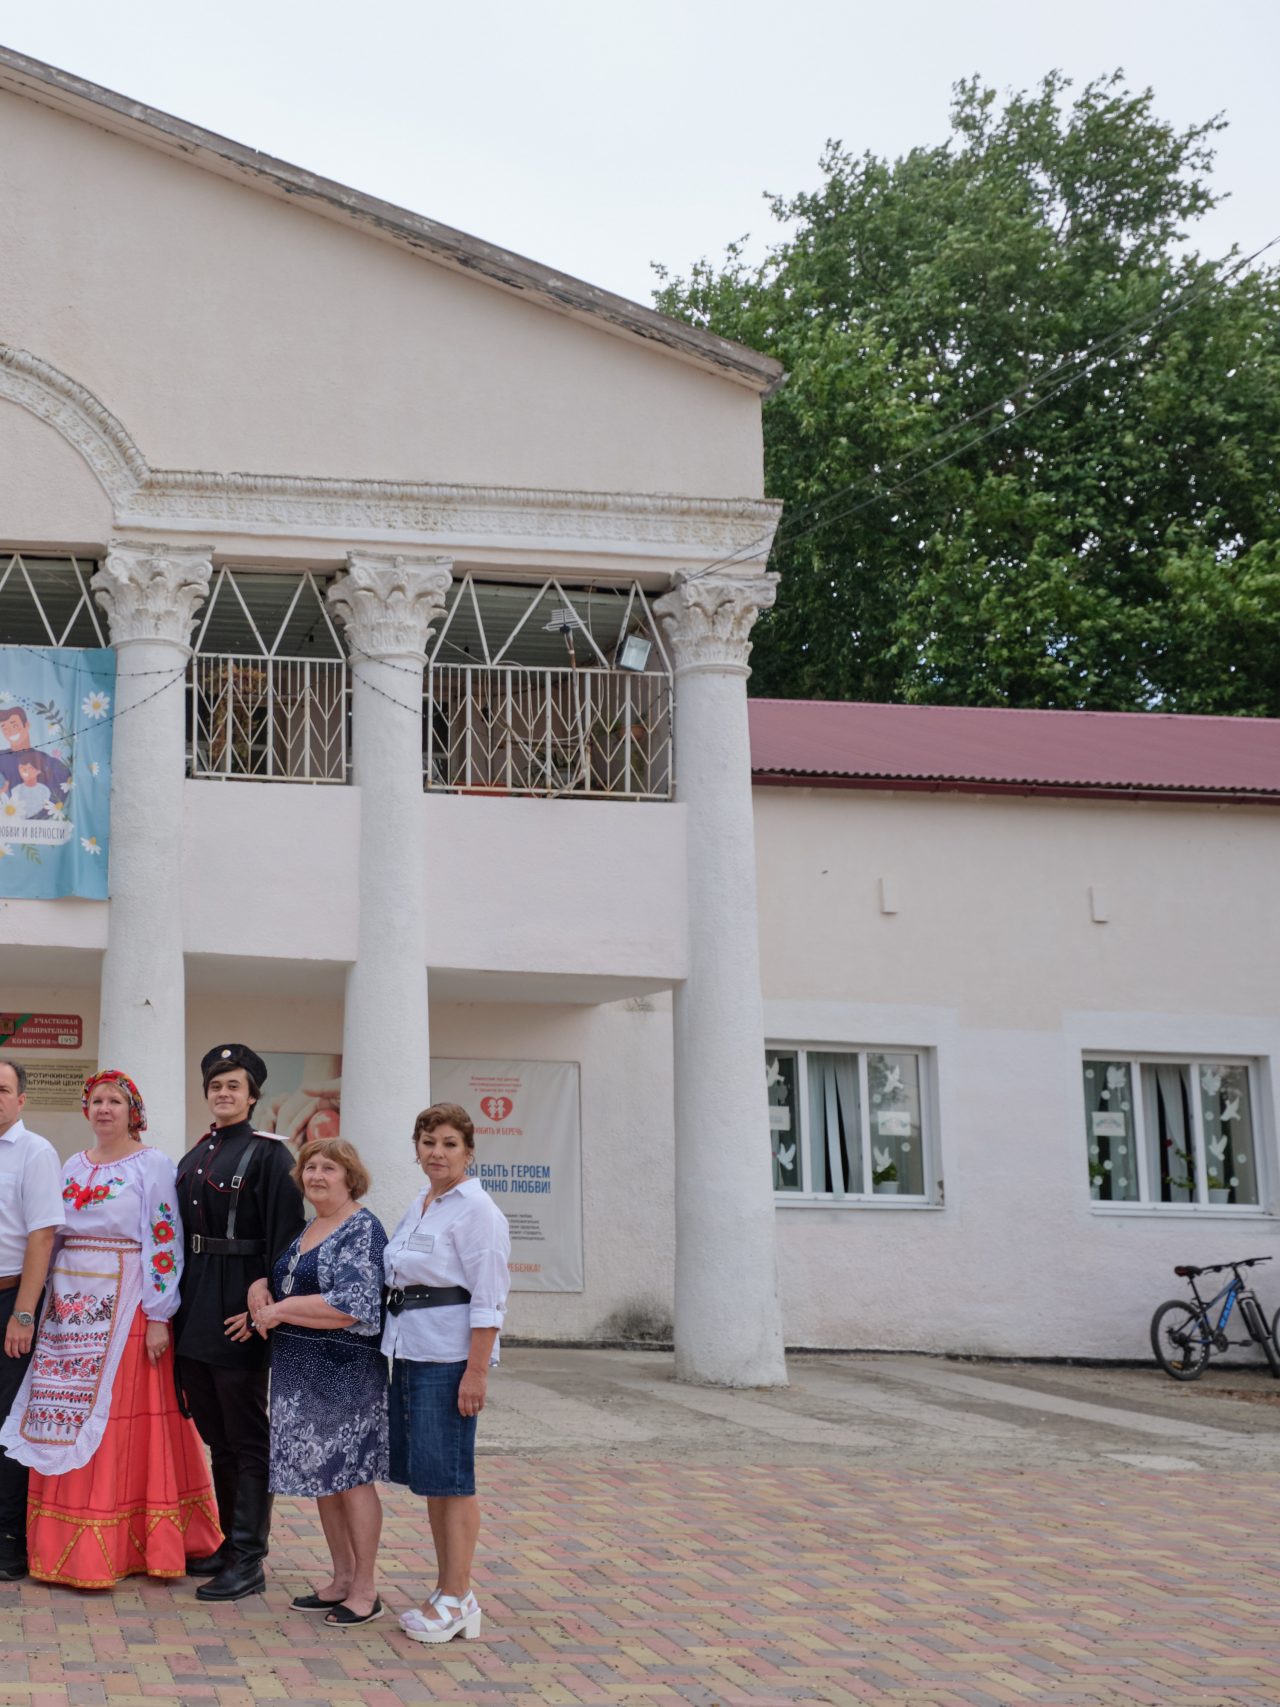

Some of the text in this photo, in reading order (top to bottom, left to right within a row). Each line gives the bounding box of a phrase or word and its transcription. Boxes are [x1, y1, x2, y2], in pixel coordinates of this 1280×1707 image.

[21, 826, 28, 838] И
[30, 827, 65, 840] ВЕРНОСТИ
[12, 1037, 51, 1045] КОМИССИЯ
[480, 1164, 509, 1177] БЫТЬ
[511, 1165, 551, 1178] ГЕРОЕМ
[510, 1180, 551, 1194] ЛЮБВИ!
